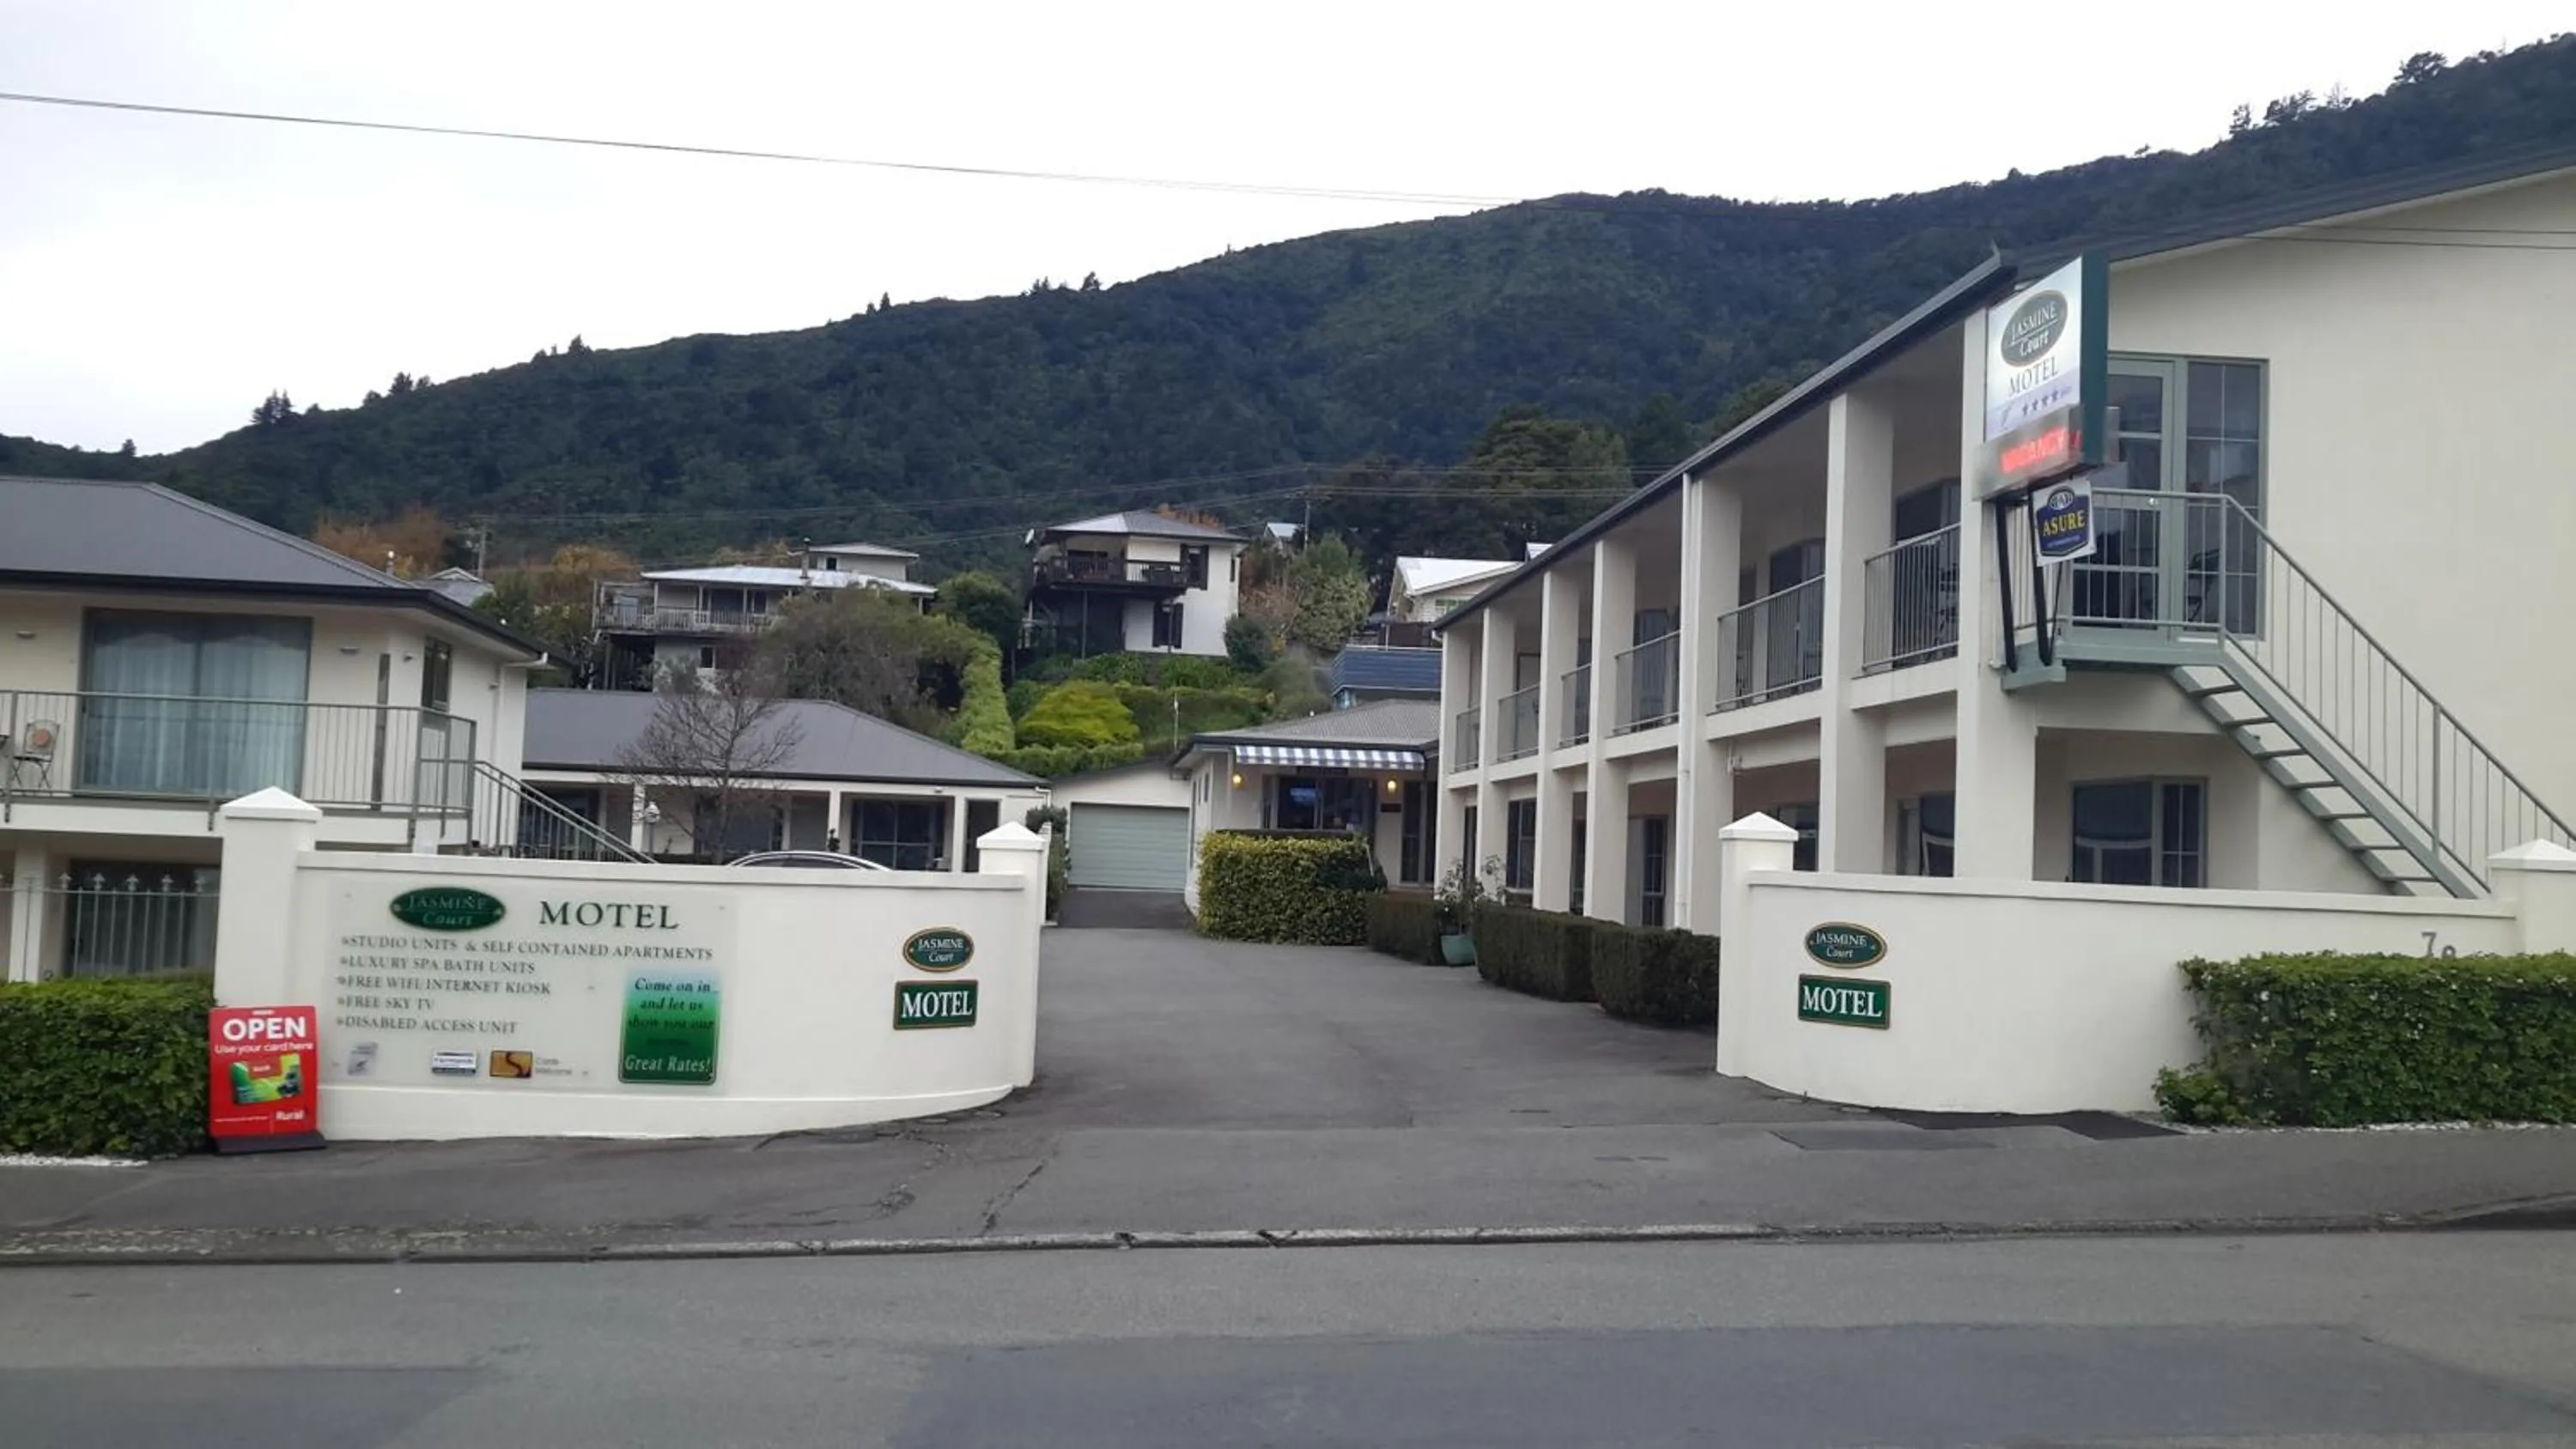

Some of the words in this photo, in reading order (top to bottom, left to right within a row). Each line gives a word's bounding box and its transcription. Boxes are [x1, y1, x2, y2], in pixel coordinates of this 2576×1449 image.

[2011, 300, 2057, 341] JASMINE
[2019, 330, 2049, 357] Court
[2010, 356, 2058, 395] MOTEL
[2043, 510, 2086, 536] ASURE
[409, 894, 488, 911] JASMINE
[422, 912, 473, 927] Court
[539, 900, 679, 930] MOTEL
[348, 935, 407, 949] STUDIO
[411, 937, 457, 951] UNITS
[465, 941, 477, 952] &
[482, 941, 514, 953] SELF
[517, 942, 609, 957] CONTAINED
[612, 946, 714, 961] APARTMENTS
[918, 938, 963, 949] JASMINE
[1815, 931, 1868, 947] JASMINE
[928, 951, 954, 962] Court
[1826, 946, 1855, 959] Court
[349, 955, 408, 969] LUXURY
[413, 957, 440, 970] SPA
[444, 959, 483, 972] BATH
[489, 961, 536, 974] UNITS
[348, 974, 383, 988] FREE
[426, 979, 500, 993] INTERNET
[505, 981, 550, 995] KIOSK
[635, 978, 672, 991] Come
[676, 982, 694, 991] on
[697, 980, 711, 991] in
[346, 995, 380, 1009] FREE
[384, 997, 410, 1009] SKY
[416, 997, 434, 1010] TV
[640, 997, 665, 1009] and
[669, 997, 686, 1009] let
[902, 991, 972, 1018] MOTEL
[1802, 985, 1882, 1017] MOTEL
[222, 1016, 307, 1041] OPEN
[345, 1016, 417, 1030] DISABLED
[423, 1019, 476, 1032] ACCESS
[479, 1021, 519, 1034] UNIT
[215, 1045, 237, 1054] Use
[237, 1045, 261, 1056] your
[264, 1043, 287, 1052] card
[289, 1041, 313, 1051] here
[625, 1054, 662, 1071] Great
[667, 1056, 711, 1072] Rates!
[276, 1110, 304, 1120] Rural
